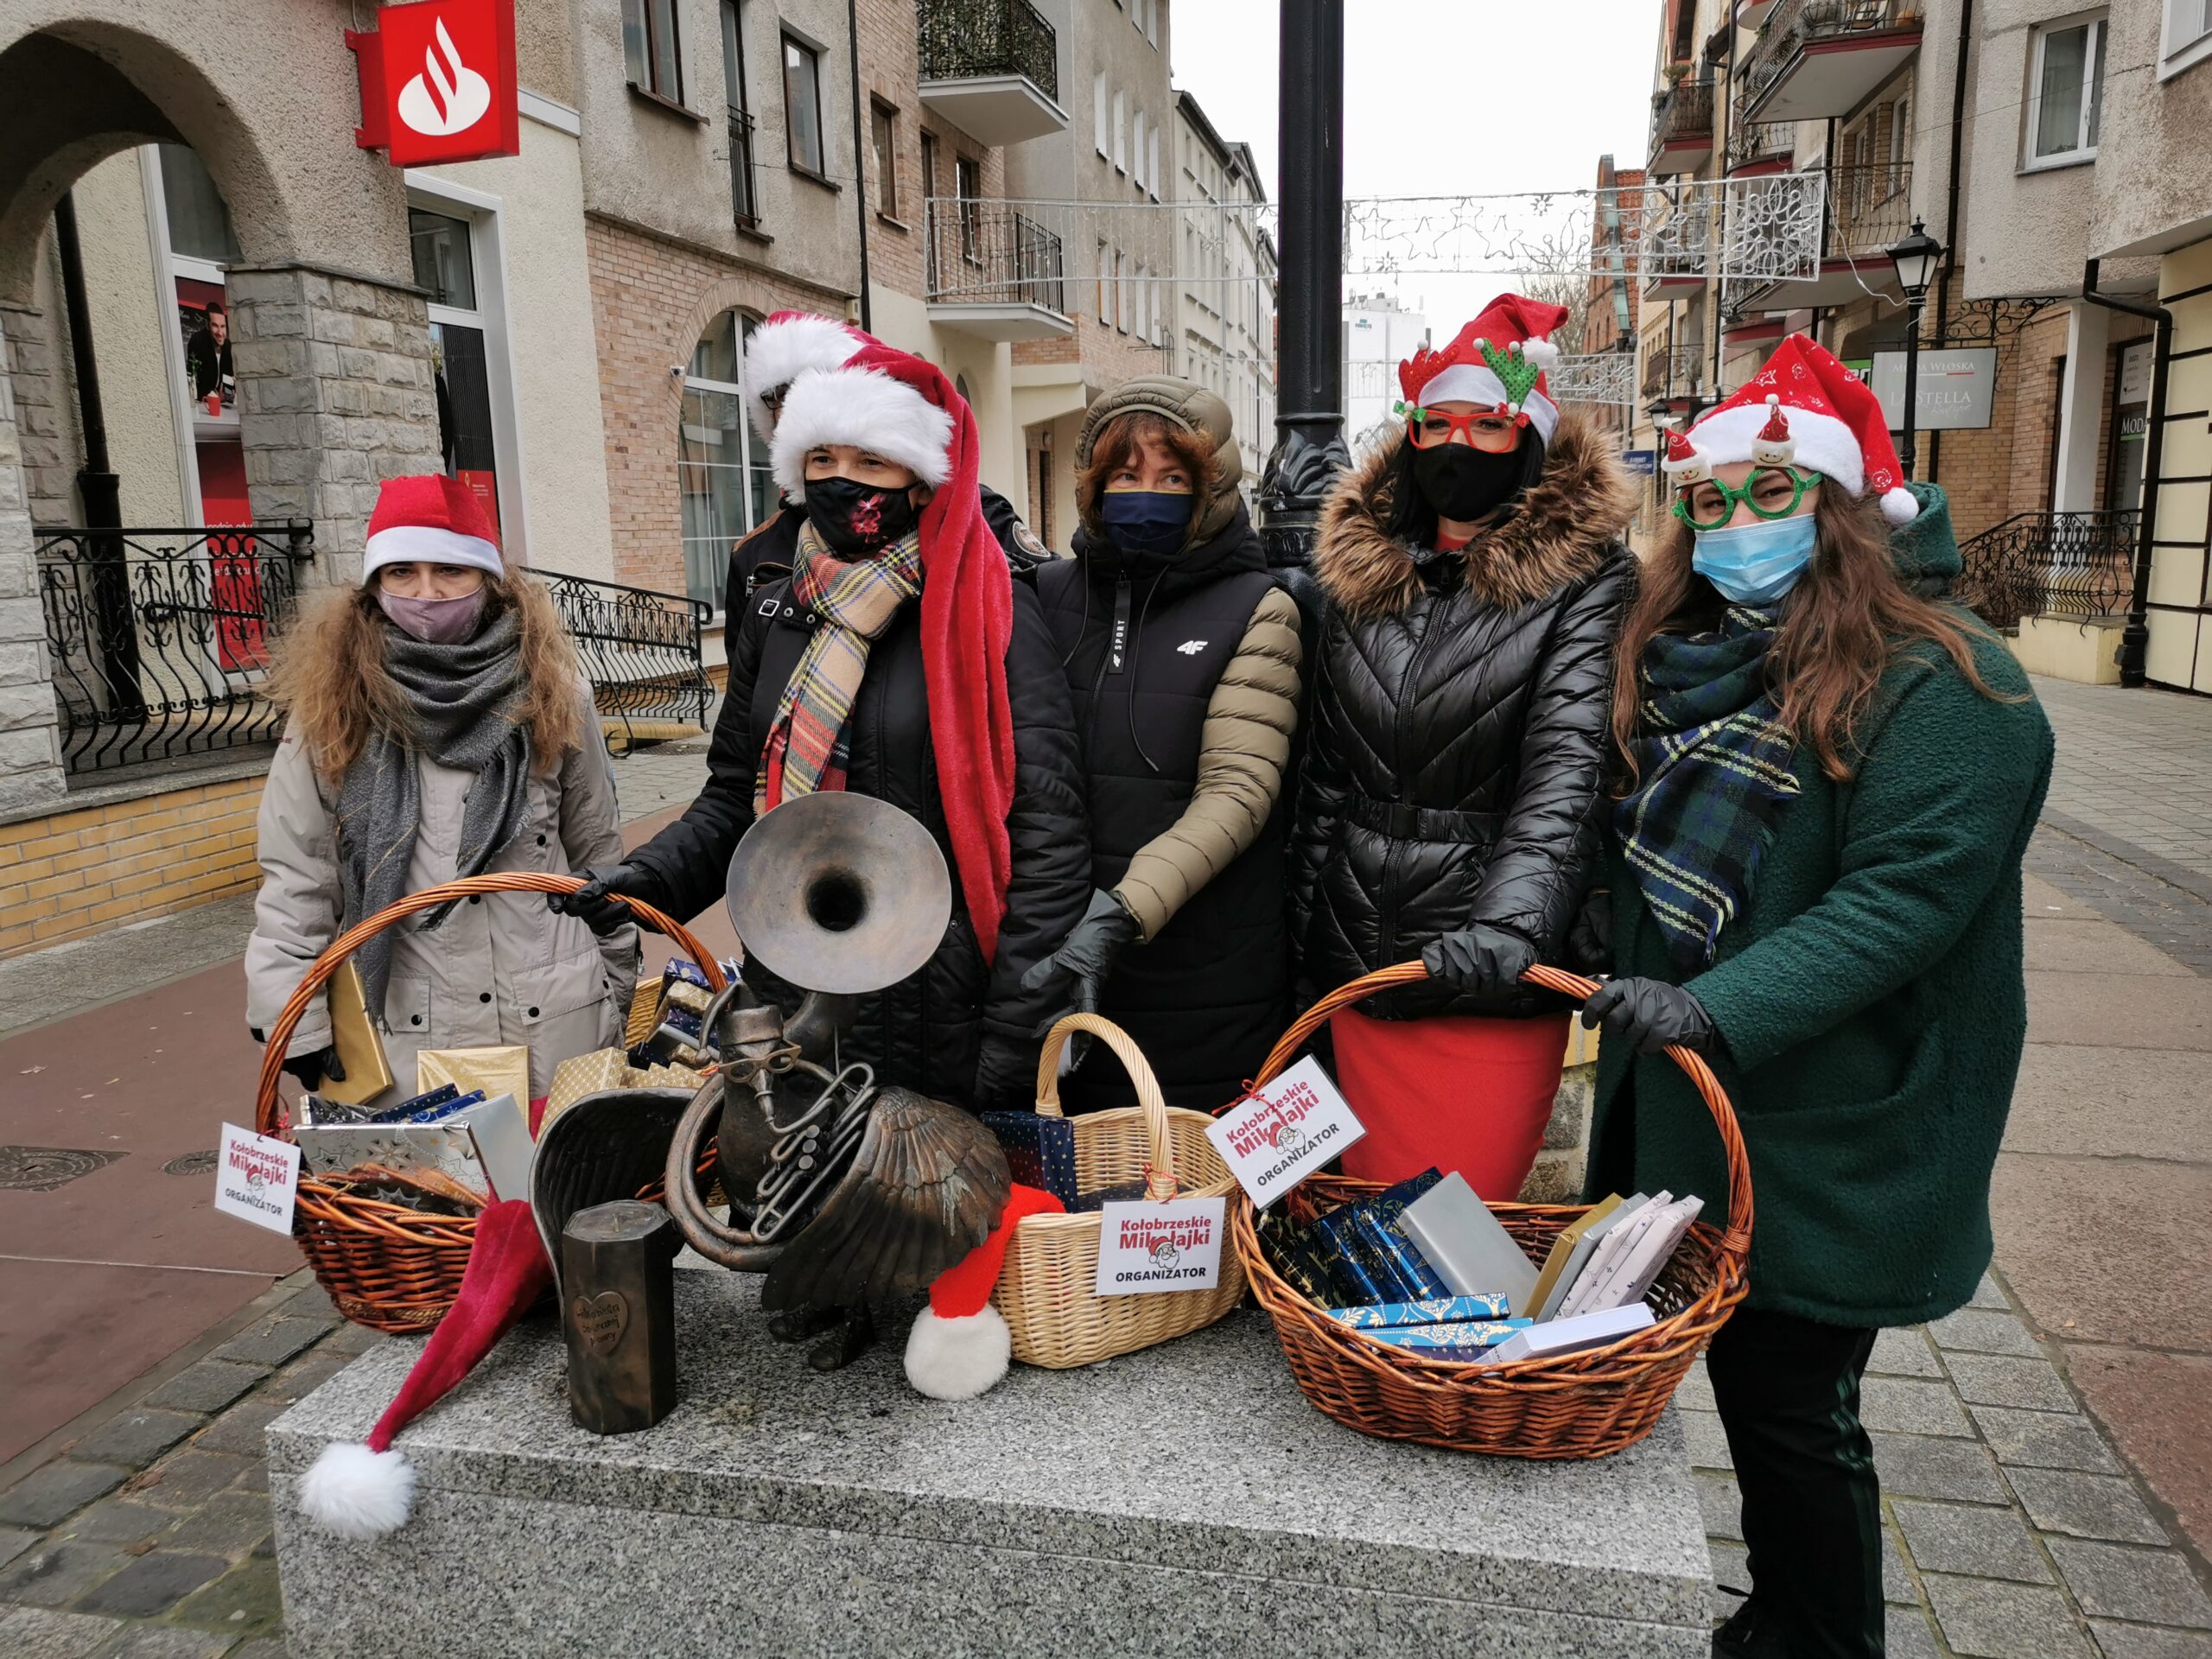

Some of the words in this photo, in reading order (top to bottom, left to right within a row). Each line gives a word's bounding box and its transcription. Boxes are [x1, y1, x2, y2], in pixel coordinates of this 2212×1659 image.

[1930, 361, 1974, 371] WŁOSKA
[1916, 391, 1971, 405] STELLA
[1114, 620, 1125, 651] SPORT
[1226, 1080, 1308, 1144] Kołobrzeskie
[1234, 1090, 1319, 1159] Mikłajki
[230, 1138, 289, 1168] Kołobrzeskie
[1257, 1122, 1340, 1186] ORGANIZATOR
[228, 1152, 288, 1185] Mikłajki
[225, 1188, 283, 1216] ORGANIZATOR
[1121, 1216, 1211, 1232] Kołobrzeskie
[1119, 1228, 1211, 1250] Mikłajki
[1116, 1267, 1206, 1282] ORGANIZATOR
